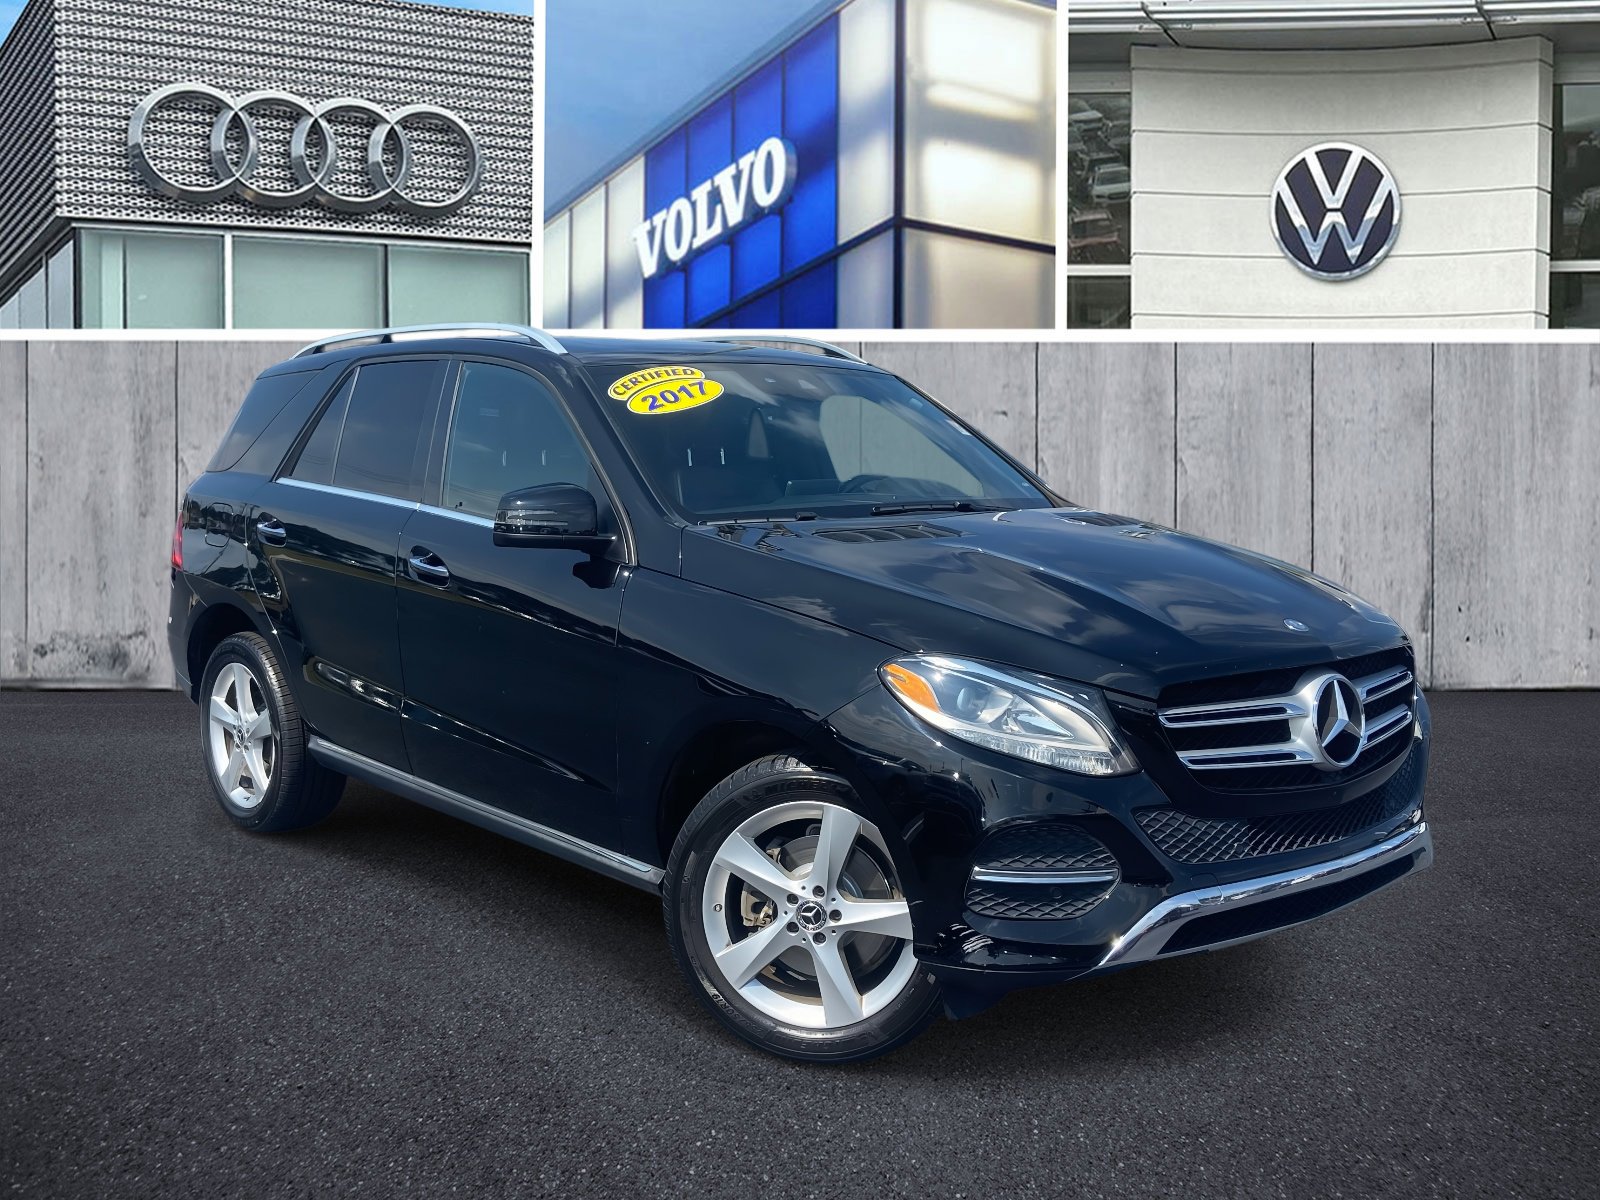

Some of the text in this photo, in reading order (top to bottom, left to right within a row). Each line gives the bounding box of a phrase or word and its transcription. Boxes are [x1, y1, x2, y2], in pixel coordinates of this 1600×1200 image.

[631, 136, 787, 279] VOLVO
[612, 367, 696, 396] CERTIFIED
[641, 380, 707, 411] 2017
